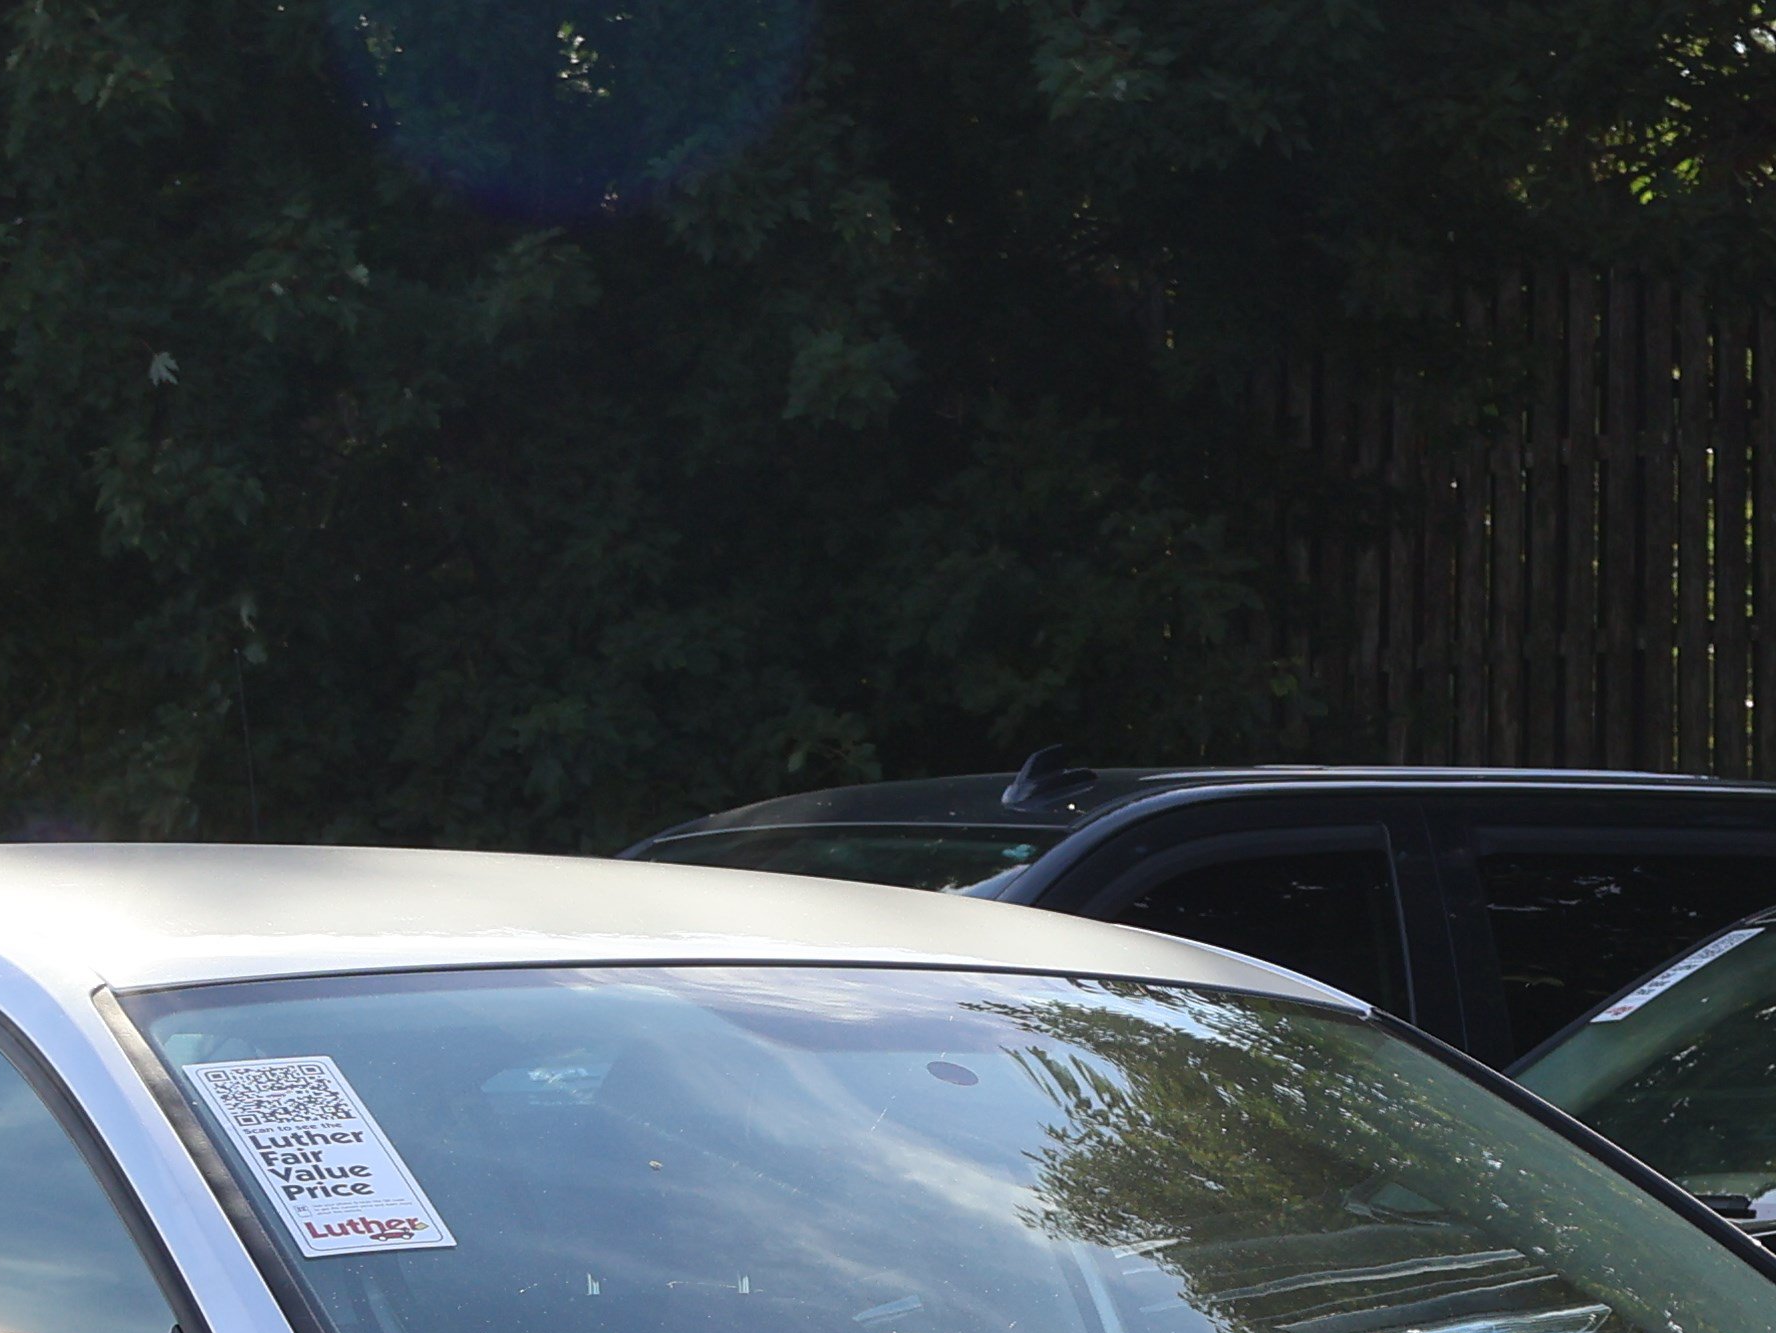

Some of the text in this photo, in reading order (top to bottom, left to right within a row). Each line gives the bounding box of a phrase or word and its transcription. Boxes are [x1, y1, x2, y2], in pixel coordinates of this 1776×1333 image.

[243, 1127, 274, 1135] Scan
[249, 1130, 364, 1150] Luther
[259, 1148, 323, 1167] Fair
[267, 1164, 373, 1184] Value
[281, 1181, 375, 1201] Price
[304, 1216, 419, 1239] Luther
